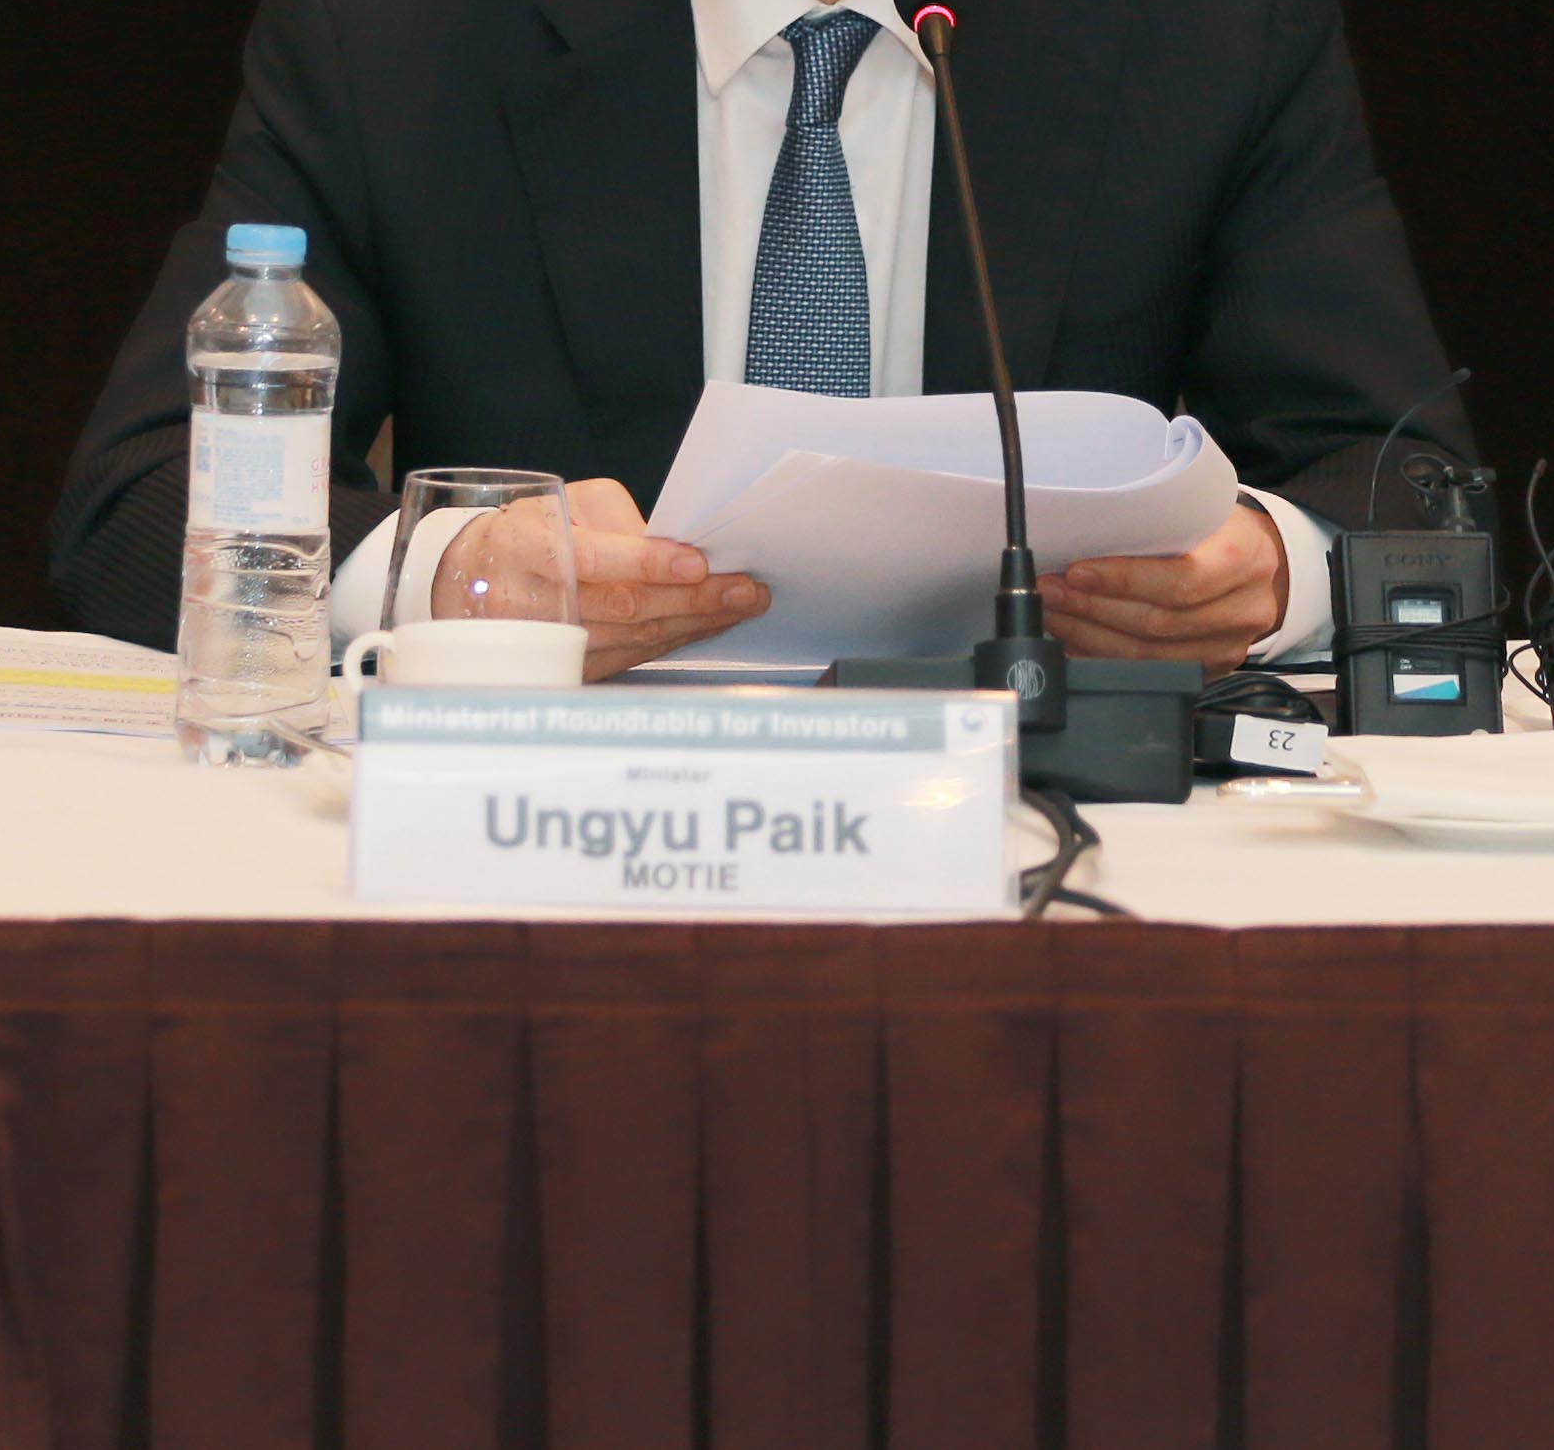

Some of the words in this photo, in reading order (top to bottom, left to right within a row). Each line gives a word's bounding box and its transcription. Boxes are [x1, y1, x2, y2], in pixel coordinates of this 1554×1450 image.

[377, 702, 540, 732] Ministerial
[546, 706, 713, 736] Roundtable
[719, 709, 763, 737] for
[769, 711, 909, 740] Investors
[1268, 729, 1296, 751] 23
[625, 766, 711, 784] Minister
[485, 794, 700, 859] Ungyu
[724, 799, 870, 854] Paik
[622, 861, 739, 892] MOTIE
